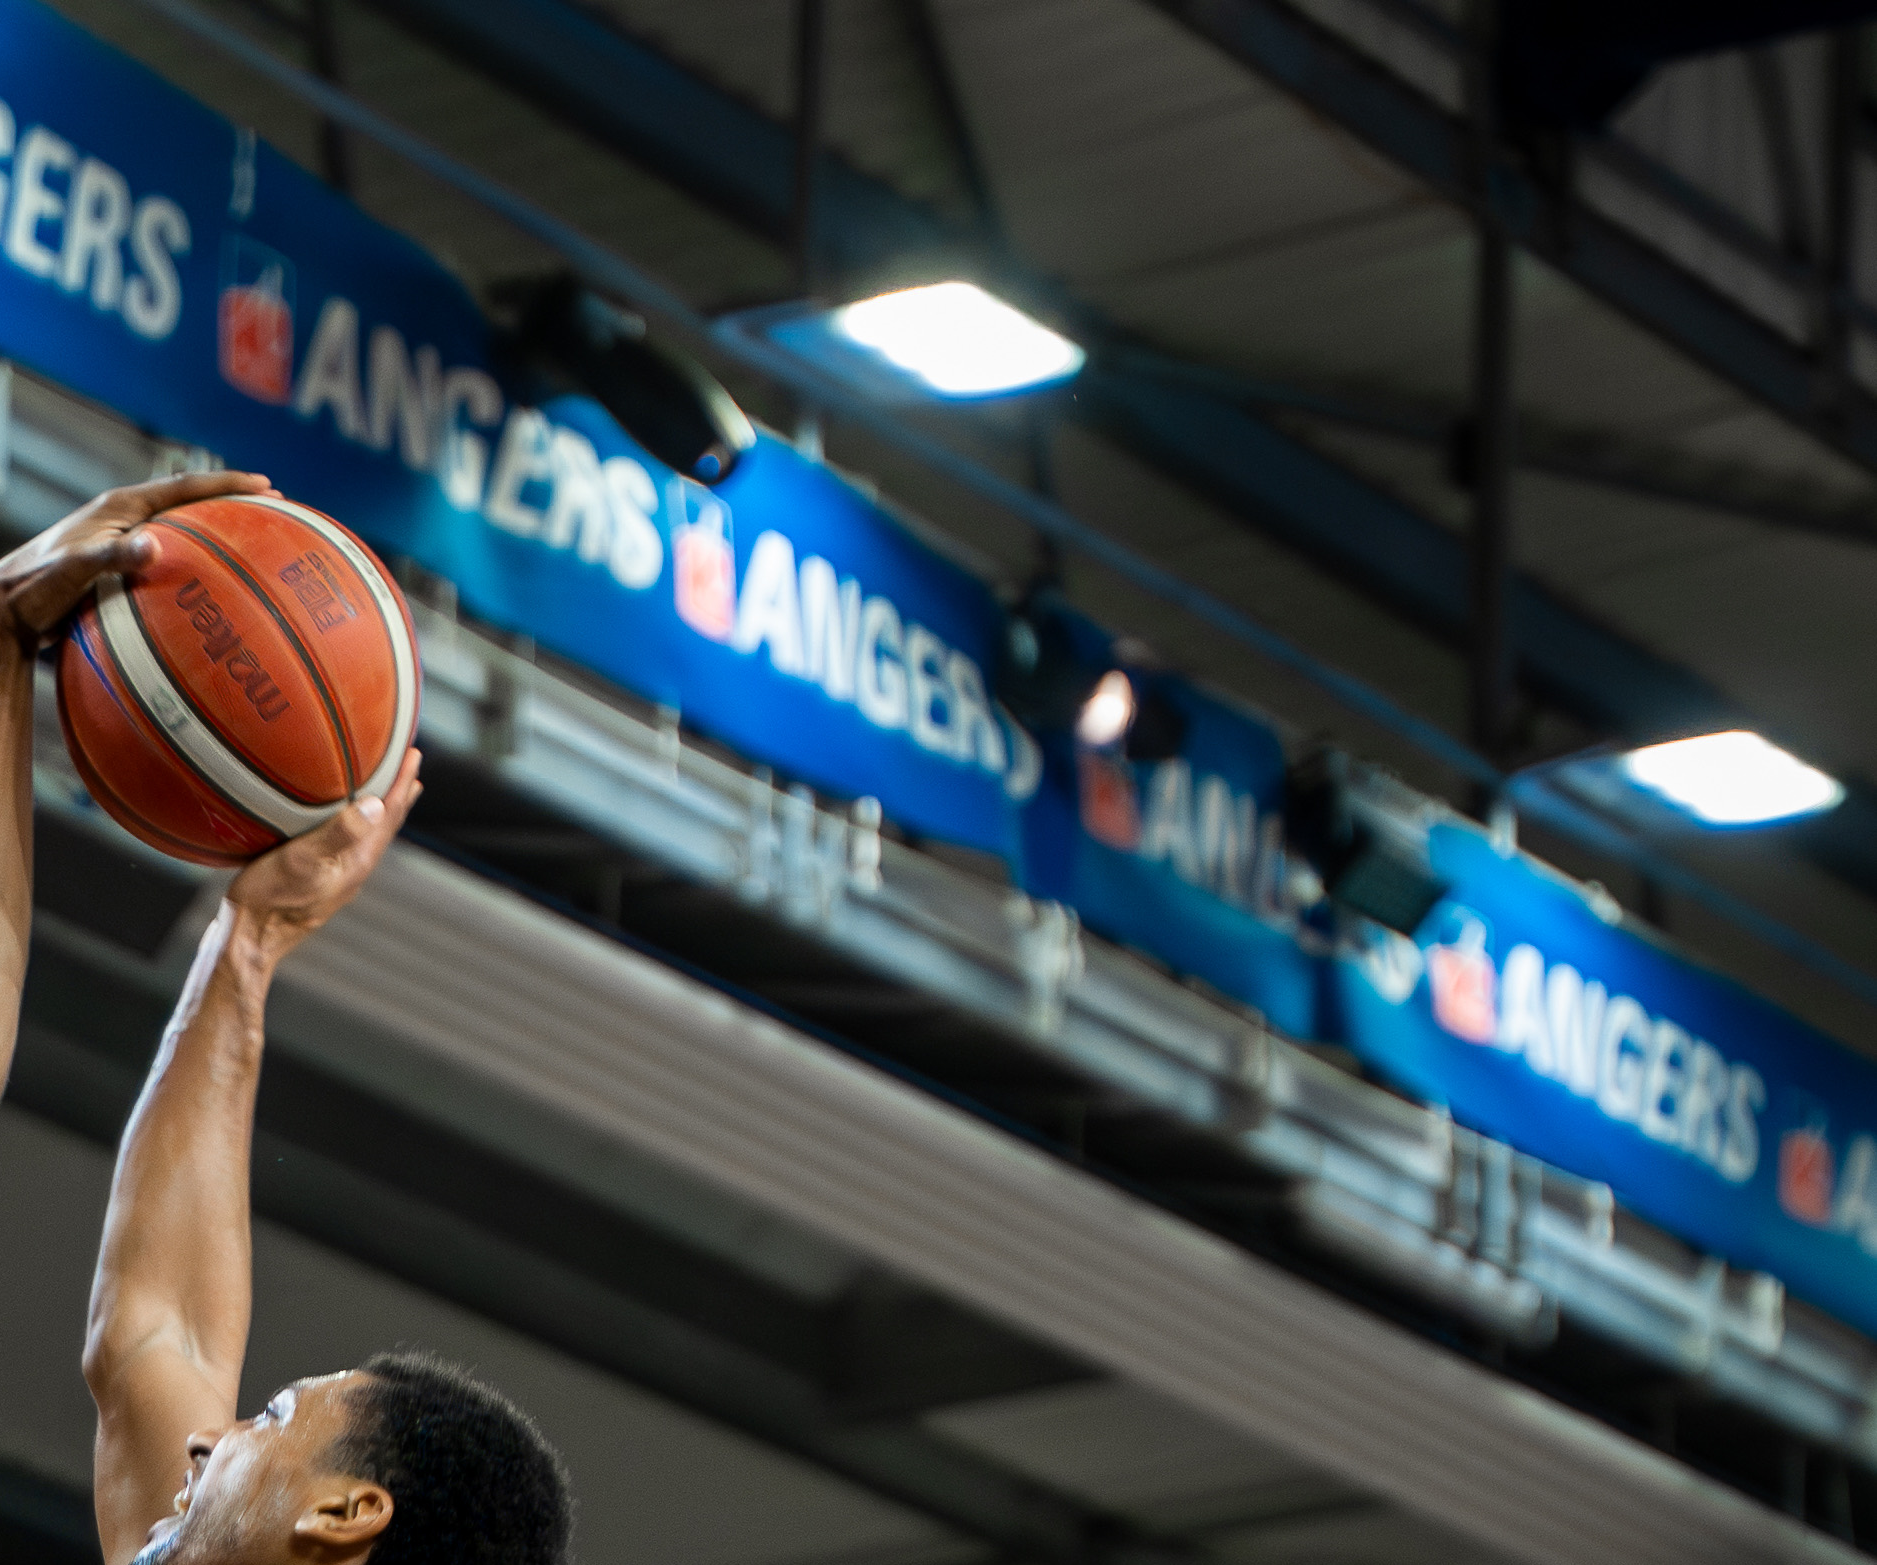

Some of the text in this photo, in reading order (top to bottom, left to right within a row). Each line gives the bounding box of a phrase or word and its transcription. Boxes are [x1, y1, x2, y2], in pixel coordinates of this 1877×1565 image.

[294, 298, 663, 590] ANGERS
[175, 577, 290, 722] molten
[1497, 944, 1766, 1184] ANGERS
